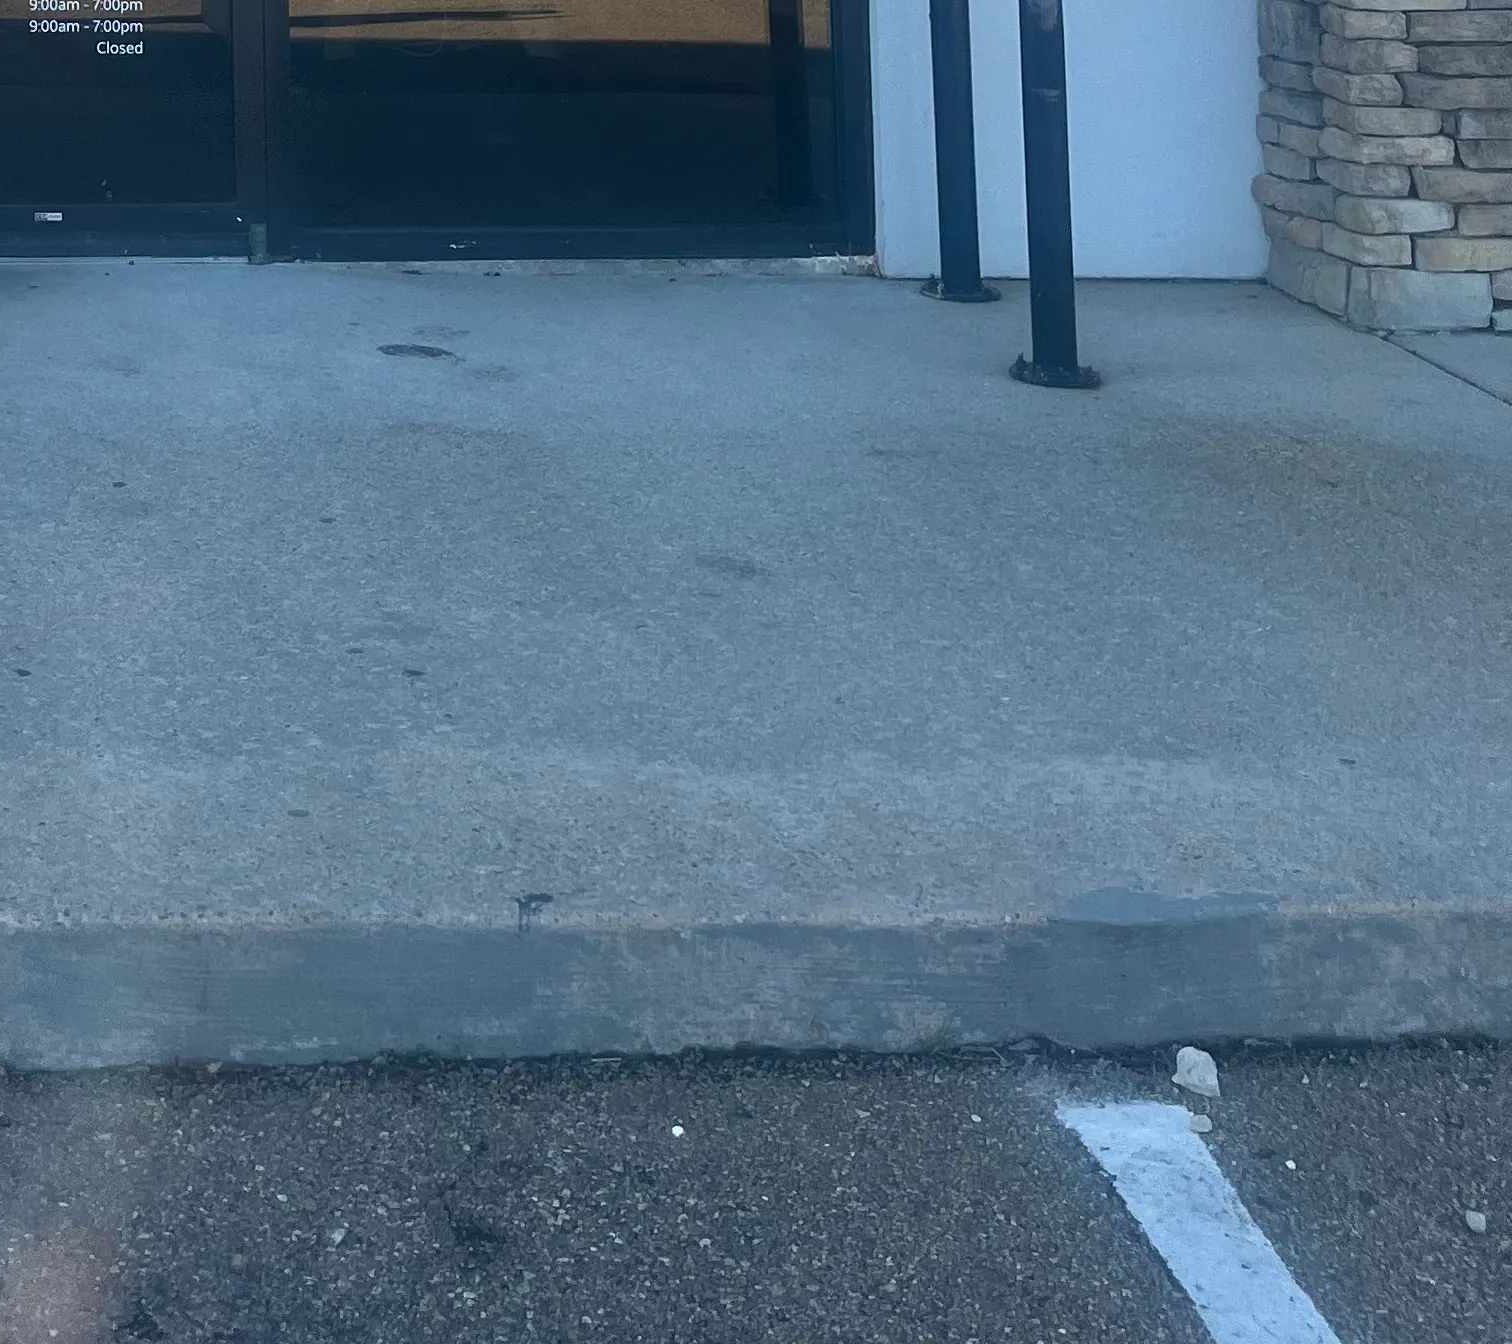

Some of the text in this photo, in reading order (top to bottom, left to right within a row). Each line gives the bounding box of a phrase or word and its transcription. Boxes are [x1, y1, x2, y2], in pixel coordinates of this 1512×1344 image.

[28, 19, 80, 33] 9:00am
[92, 19, 144, 36] 7:00pm
[96, 41, 144, 55] Closed
